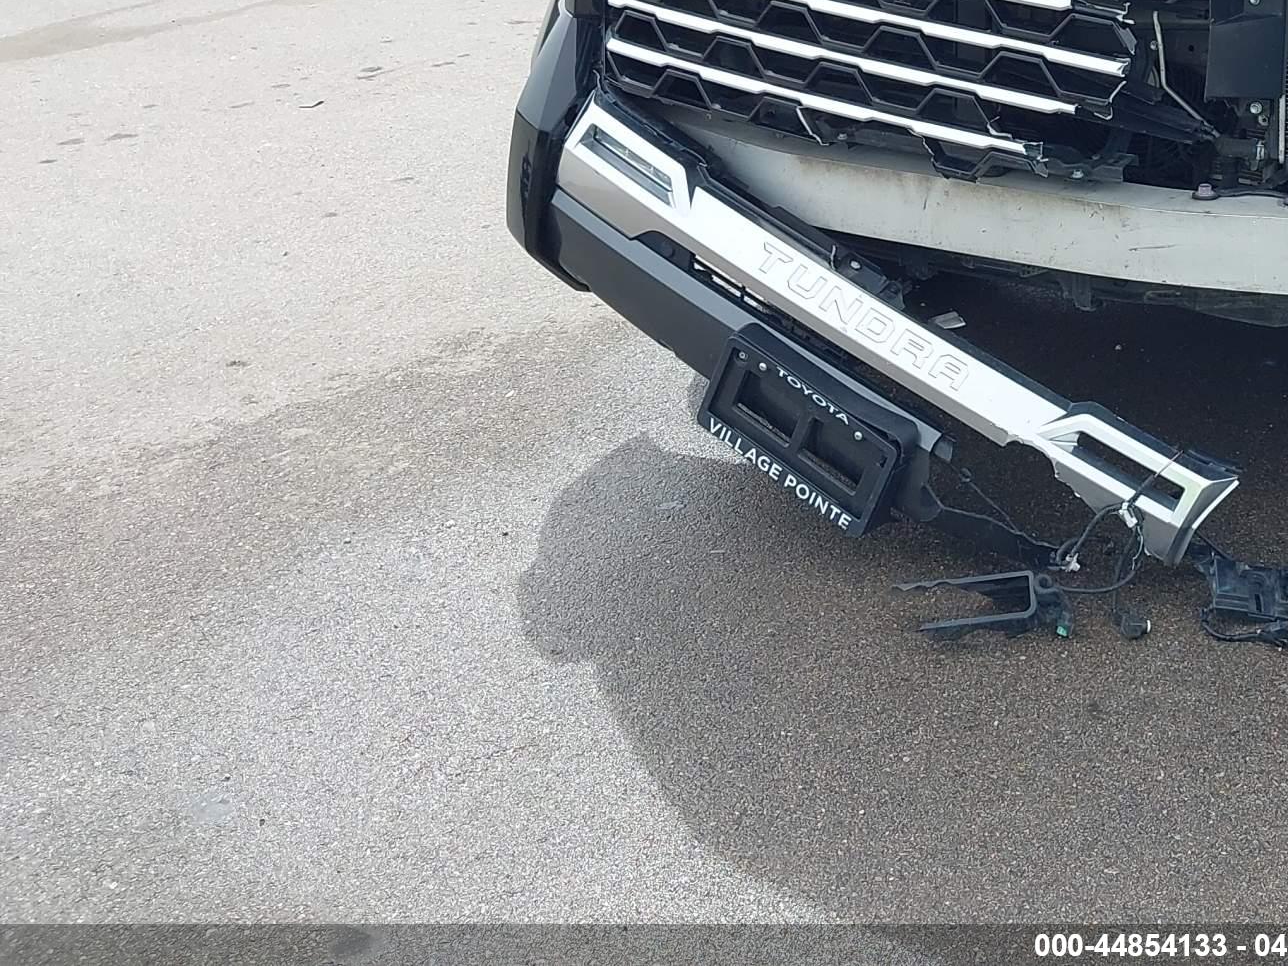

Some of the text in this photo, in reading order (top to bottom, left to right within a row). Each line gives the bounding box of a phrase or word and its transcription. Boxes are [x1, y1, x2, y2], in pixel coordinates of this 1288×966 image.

[758, 241, 970, 392] TUNDRA
[776, 366, 850, 425] TOYOTA
[708, 417, 852, 531] VILLAGE POINTE
